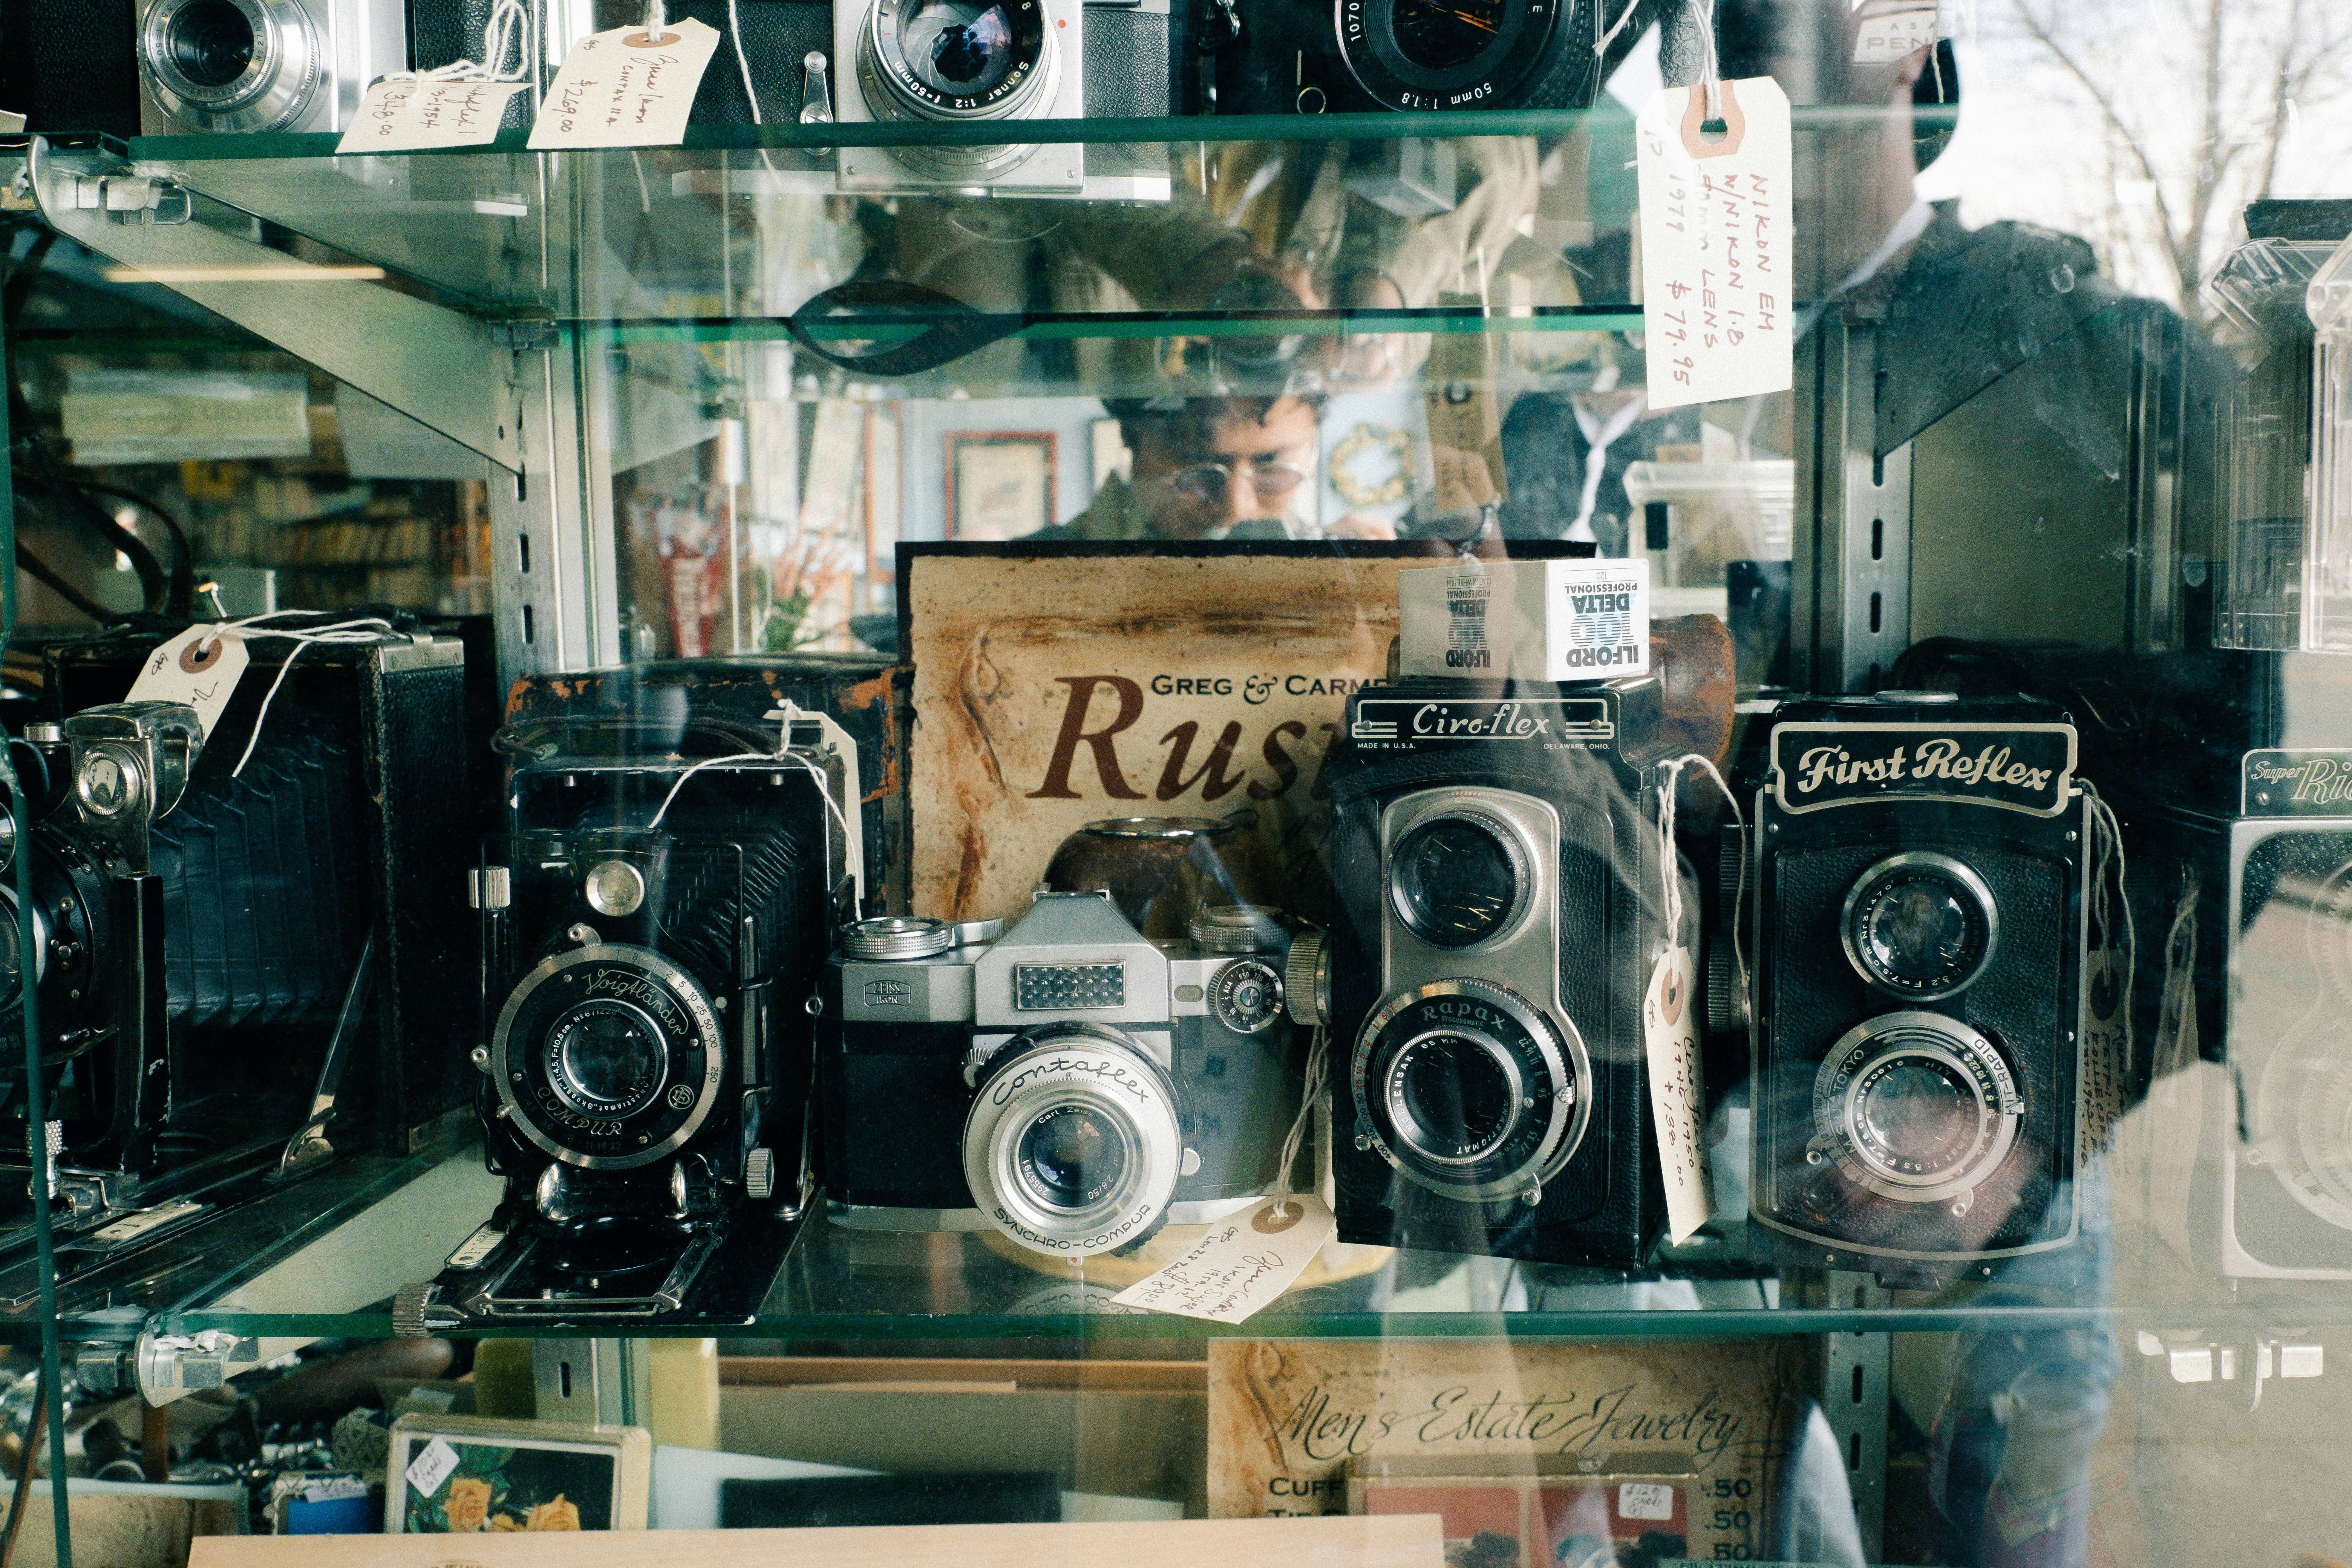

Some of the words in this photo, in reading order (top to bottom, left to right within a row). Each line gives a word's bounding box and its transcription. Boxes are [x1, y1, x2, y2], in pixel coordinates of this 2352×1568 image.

[612, 65, 634, 103] CONTAX
[988, 61, 1029, 101] Sonnar
[1401, 92, 1439, 110] 1:1.8
[1450, 82, 1492, 105] 50mm
[955, 98, 977, 109] 1:2
[1666, 174, 1686, 233] 1979
[1749, 173, 1772, 273] NIKON
[1702, 268, 1718, 349] LENS
[1757, 292, 1775, 331] EM
[1727, 309, 1745, 346] 1.8
[1596, 571, 1607, 580] 120
[1447, 590, 1491, 599] PROFESSIONAL
[1564, 583, 1637, 594] PROFESSIONAL
[1450, 600, 1485, 618] DELTA
[1571, 593, 1630, 614] DELTA
[1570, 612, 1635, 647] 100
[1446, 649, 1491, 668] ILFORD
[1566, 645, 1639, 668] ILFORD
[1151, 674, 1233, 695] GREG
[1243, 675, 1278, 705] &
[1413, 703, 1550, 734] Ciro-flex
[1798, 745, 1906, 792] First
[1912, 738, 2053, 791] Reflex
[2251, 760, 2306, 784] Super
[632, 952, 639, 961] B
[688, 991, 698, 1002] 10
[874, 982, 901, 994] ZEISS
[582, 969, 689, 1035] Voigtländer
[877, 995, 899, 1004] IKON
[1223, 981, 1233, 994] ASA
[1230, 1007, 1237, 1015] 10
[696, 1004, 708, 1015] 25
[1420, 1001, 1506, 1030] Rapax
[703, 1018, 713, 1030] 50
[1442, 1015, 1484, 1027] SYNCHROMATIC
[708, 1033, 718, 1048] 100
[1363, 1040, 1372, 1049] 2
[1517, 1037, 1528, 1047] 22
[1525, 1047, 1535, 1057] 16
[1529, 1057, 1539, 1066] 11
[710, 1066, 719, 1083] 250
[1356, 1065, 1366, 1075] 10
[1969, 1060, 1981, 1071] 22
[993, 1057, 1149, 1106] Contaflex
[1355, 1080, 1364, 1090] 25
[1974, 1038, 2015, 1116] HIT-RAPID
[599, 1082, 650, 1112] Anastigmat
[1356, 1093, 1364, 1104] 50
[1394, 1054, 1414, 1133] WOLLENSAK
[538, 1087, 622, 1136] COMPUR
[1038, 1109, 1060, 1124] Carl
[1066, 1106, 1094, 1117] Zeiss
[1358, 1108, 1369, 1123] 100
[1366, 1124, 1379, 1141] 200
[1456, 1099, 1508, 1155] ANASTIGMAT
[1377, 1144, 1392, 1159] 400
[1021, 1159, 1050, 1196] 2955791
[994, 1204, 1152, 1250] SYNCHRO-COMPUR
[1275, 1385, 1408, 1461] Men's
[1417, 1386, 1577, 1444] Estate
[1558, 1384, 1749, 1468] Jewelry
[1704, 1478, 1752, 1498] .50
